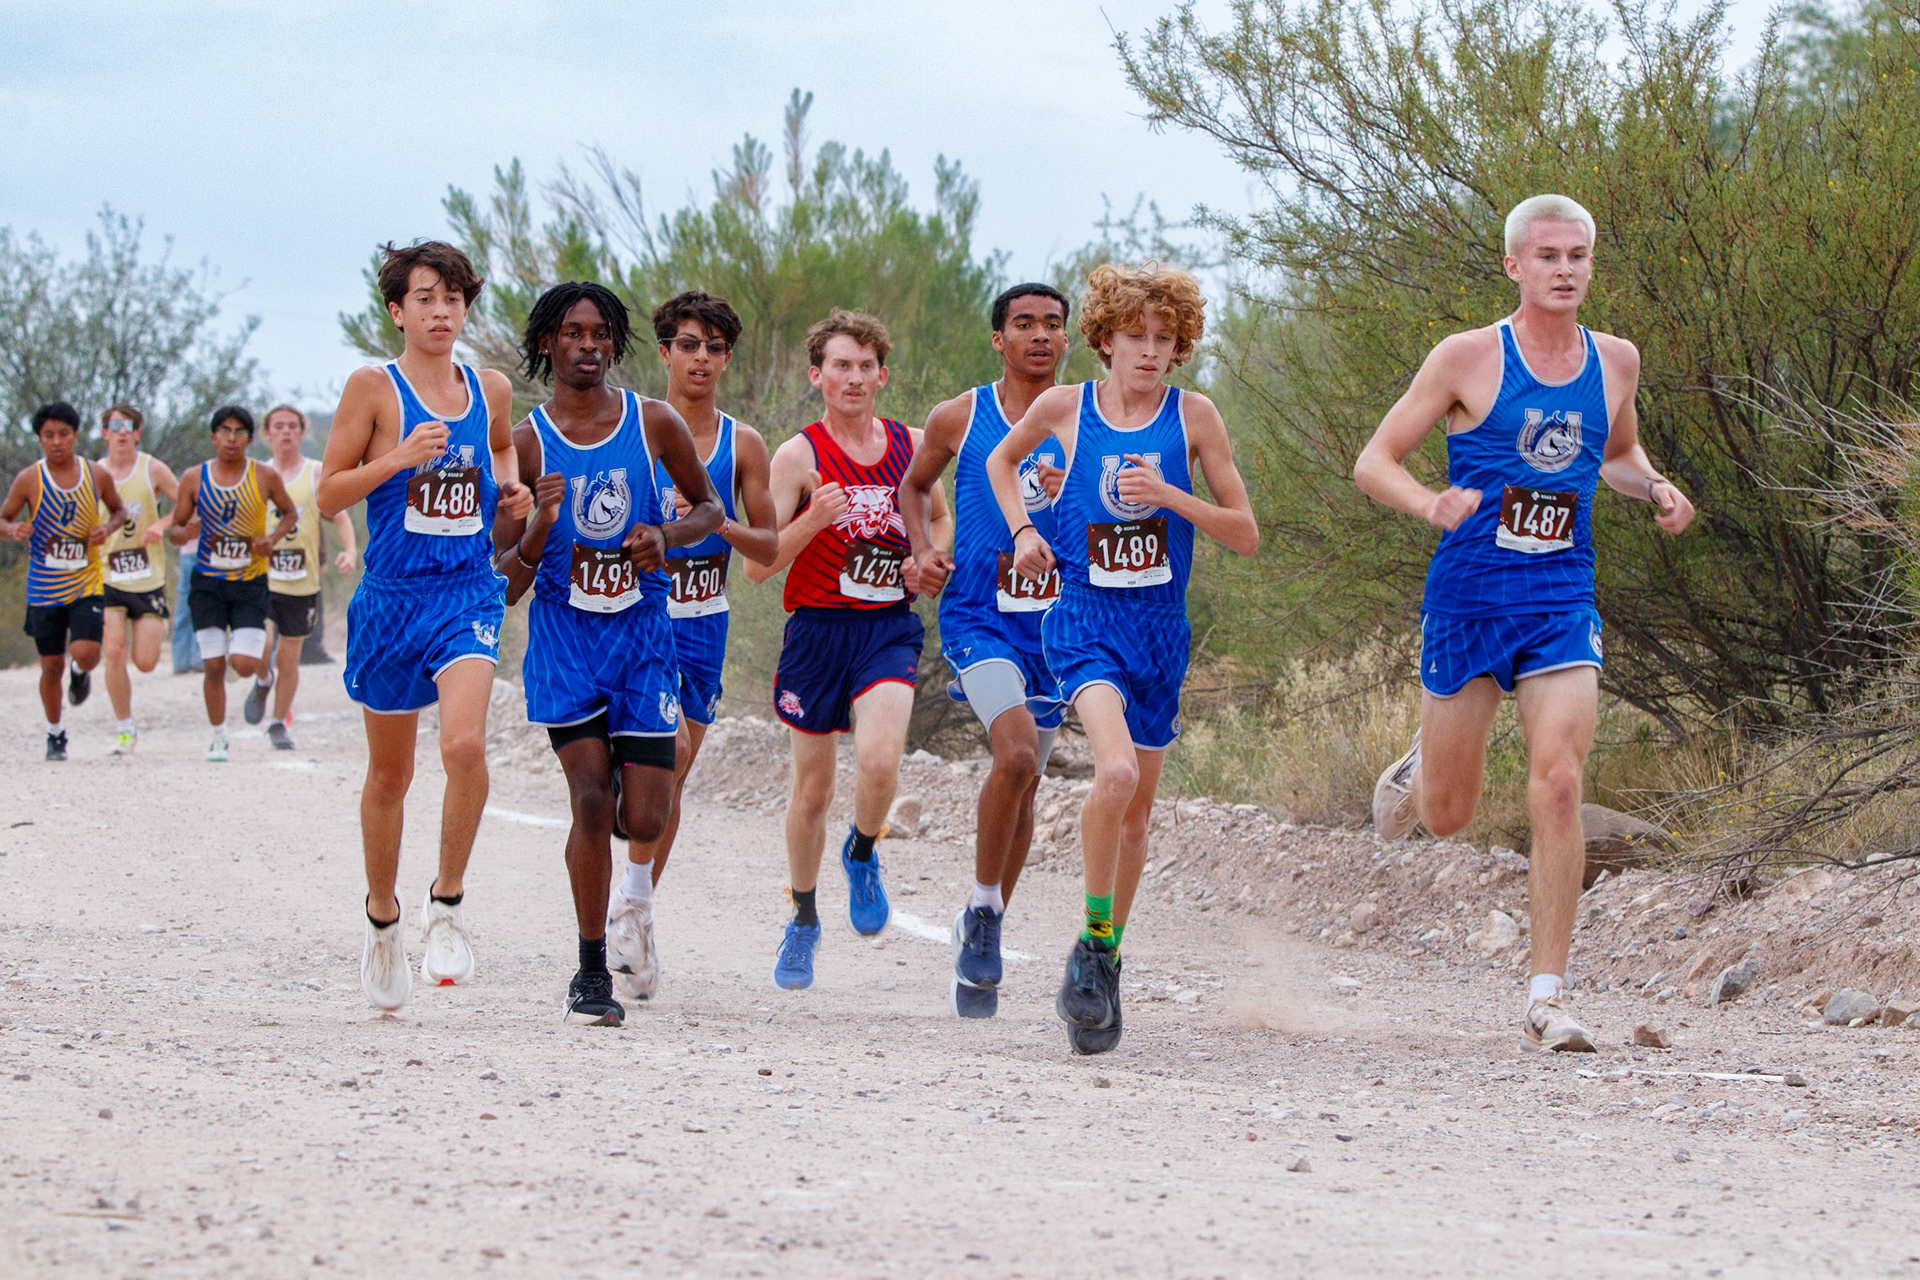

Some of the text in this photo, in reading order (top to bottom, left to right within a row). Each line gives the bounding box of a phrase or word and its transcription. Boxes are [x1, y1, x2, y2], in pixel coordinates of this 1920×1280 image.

[419, 482, 475, 515] 1488
[1511, 501, 1570, 538] 1487
[52, 542, 84, 560] 1470
[112, 553, 145, 574] 1526
[216, 541, 248, 558] 1472
[271, 554, 302, 572] 1527
[1098, 534, 1159, 569] 1489
[579, 560, 633, 594] 1493
[671, 567, 720, 600] 1490
[852, 554, 901, 586] 1475
[1007, 567, 1060, 597] 1491
